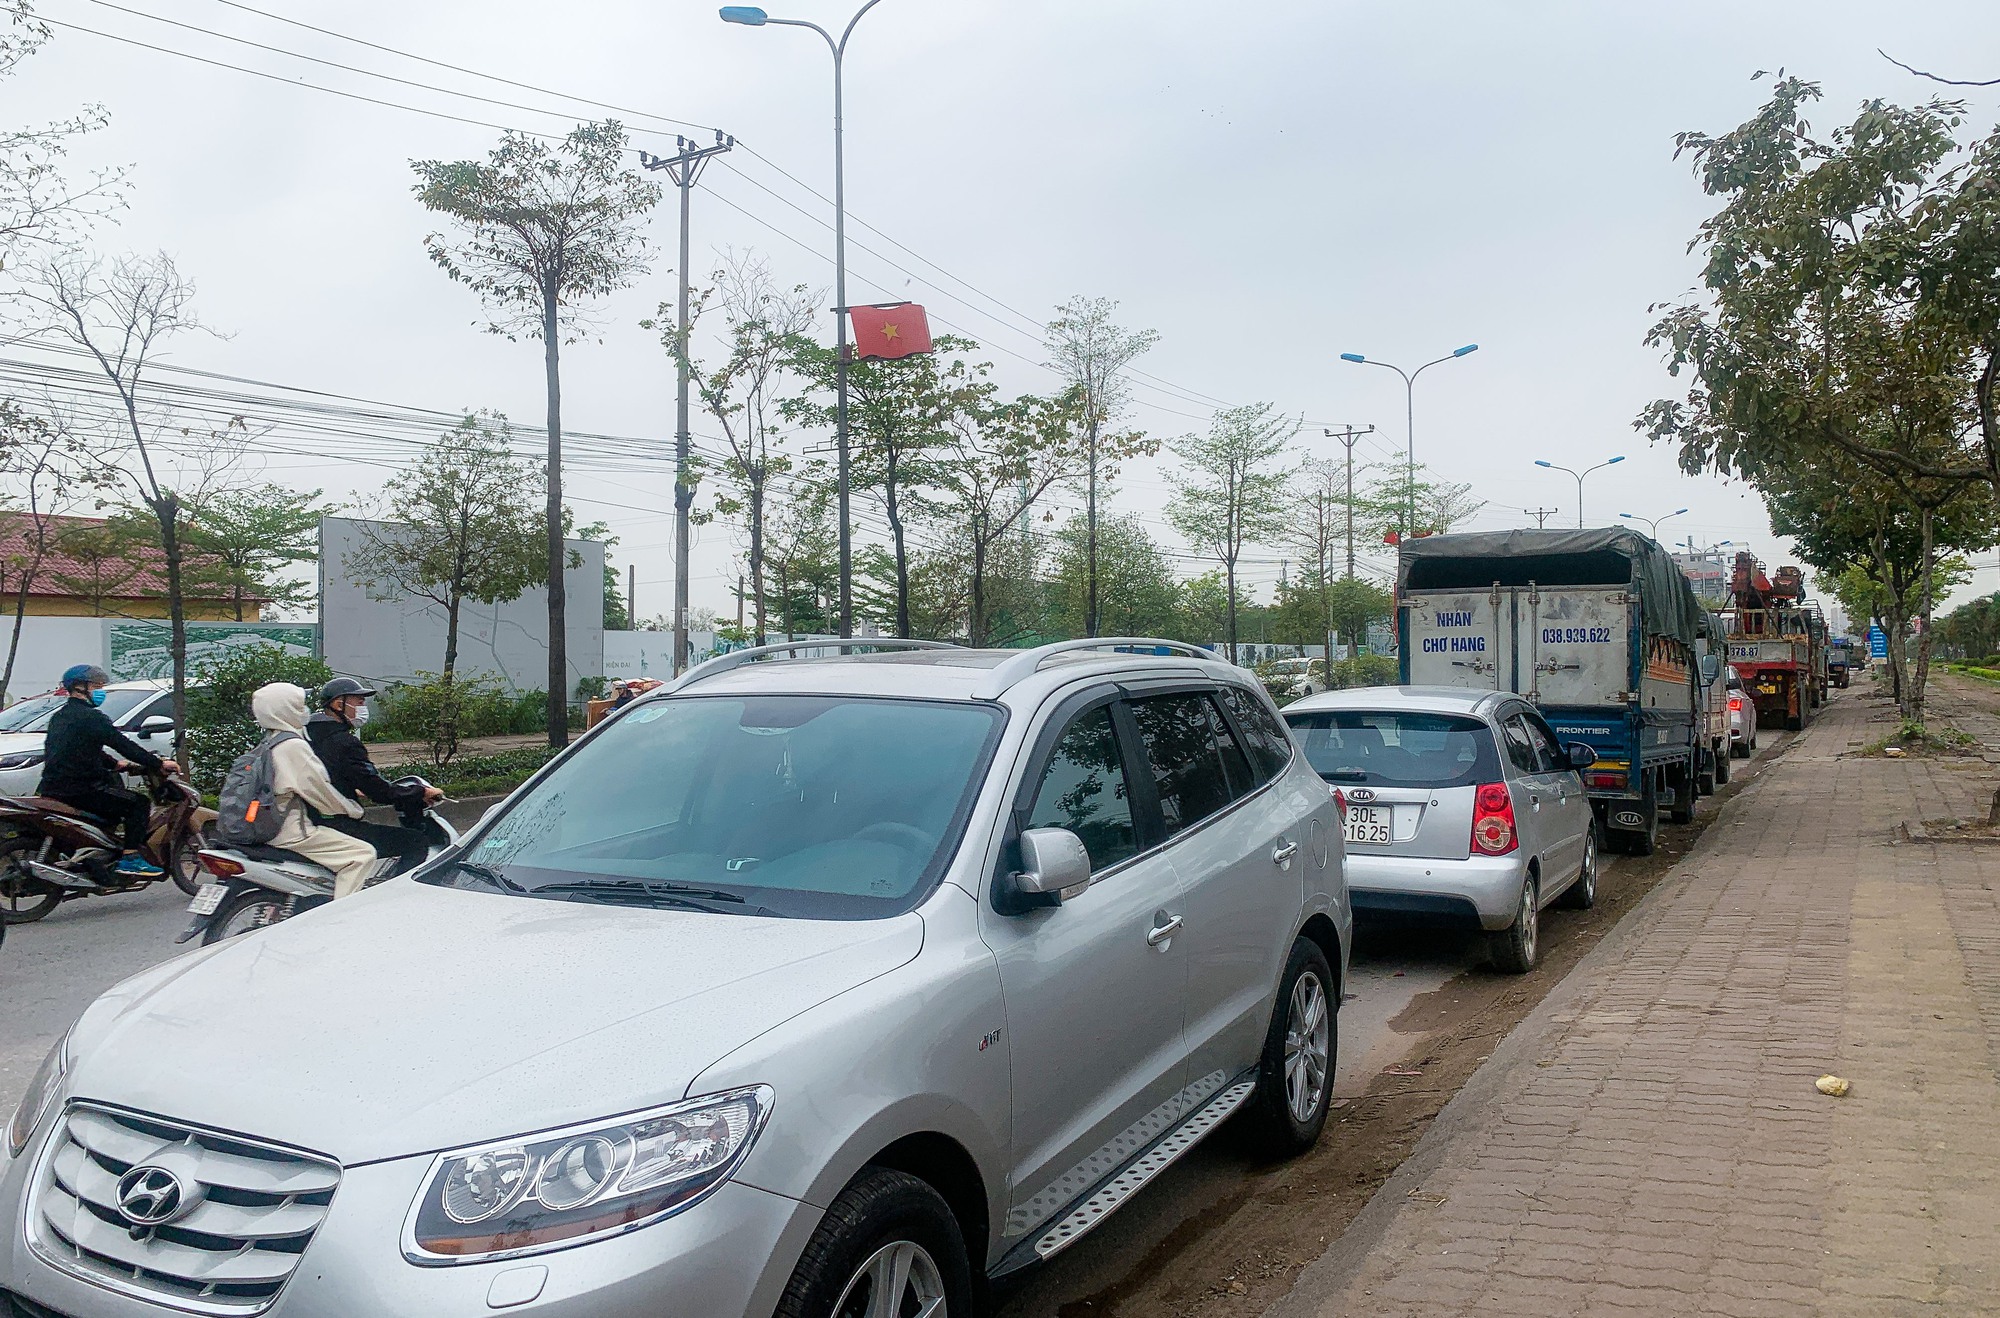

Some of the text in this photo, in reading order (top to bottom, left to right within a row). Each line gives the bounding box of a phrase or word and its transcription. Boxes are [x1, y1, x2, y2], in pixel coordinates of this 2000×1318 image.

[1542, 627, 1611, 644] 038.939.622
[1556, 726, 1611, 735] FRONTIER
[1353, 791, 1371, 799] KIA
[1350, 807, 1378, 823] 30E
[1620, 813, 1640, 823] KIA
